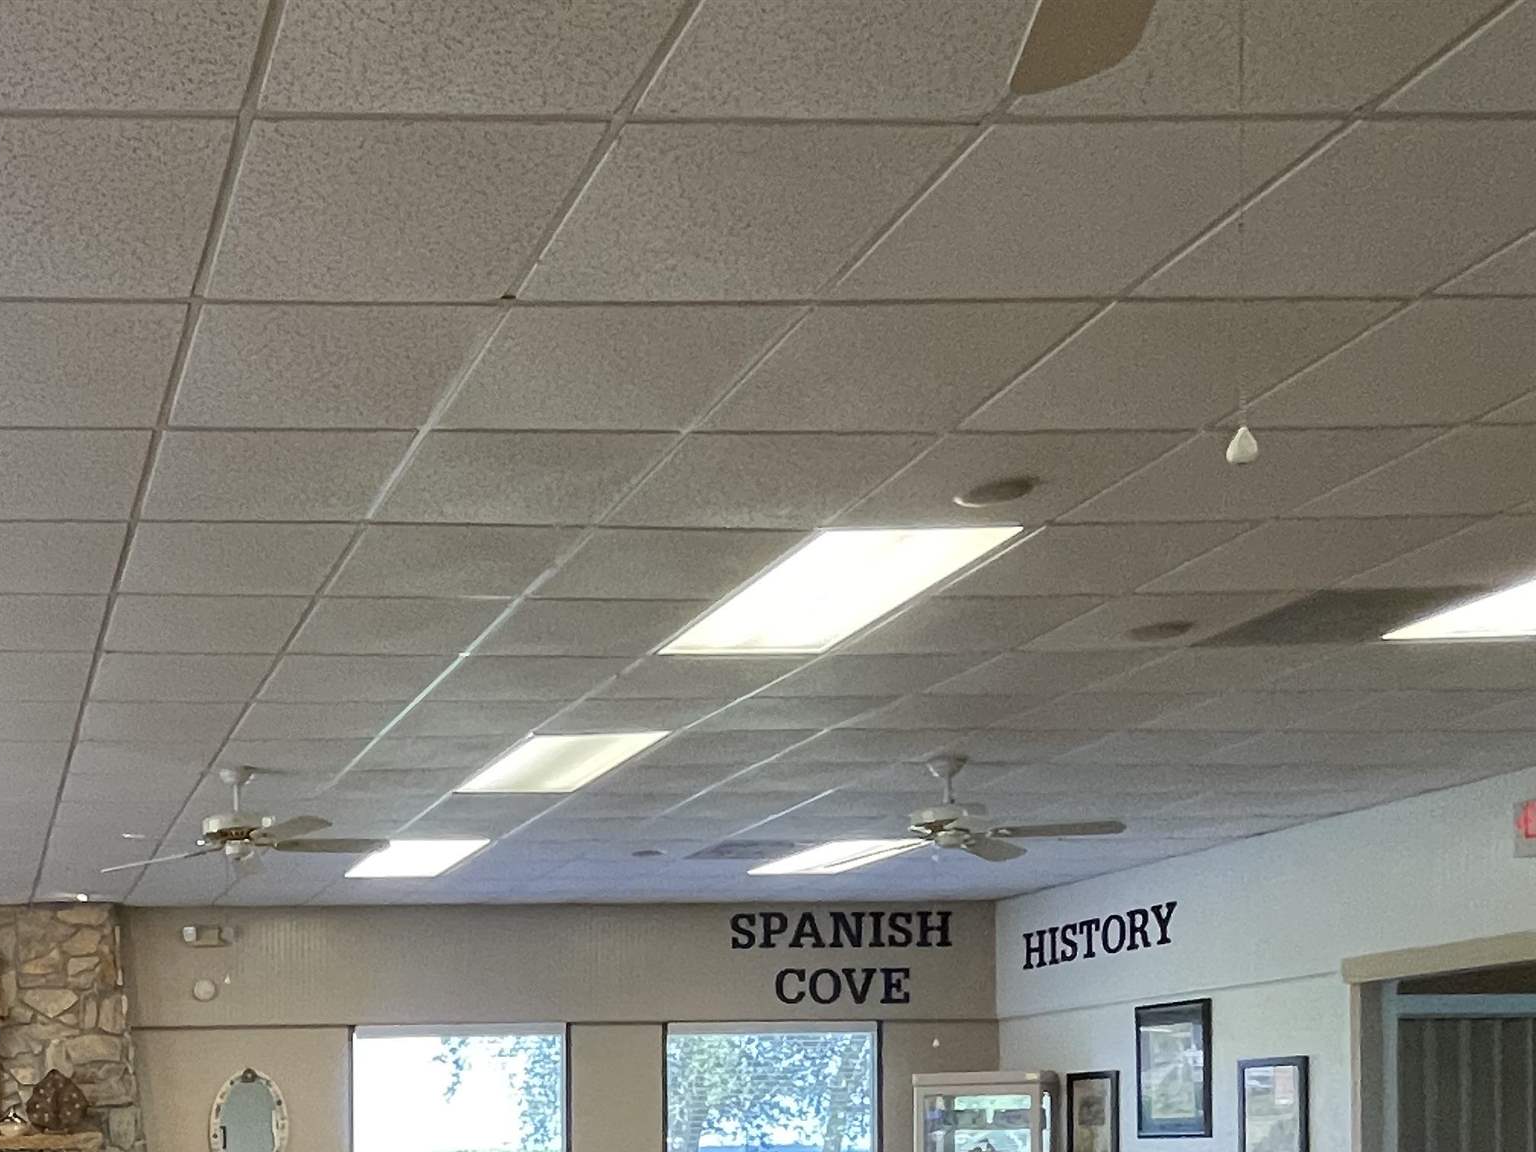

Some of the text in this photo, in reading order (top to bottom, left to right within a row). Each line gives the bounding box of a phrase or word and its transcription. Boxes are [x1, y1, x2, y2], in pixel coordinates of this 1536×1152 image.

[730, 911, 952, 949] SPANISH
[1022, 901, 1177, 970] HISTORY
[775, 967, 911, 1004] COVE
